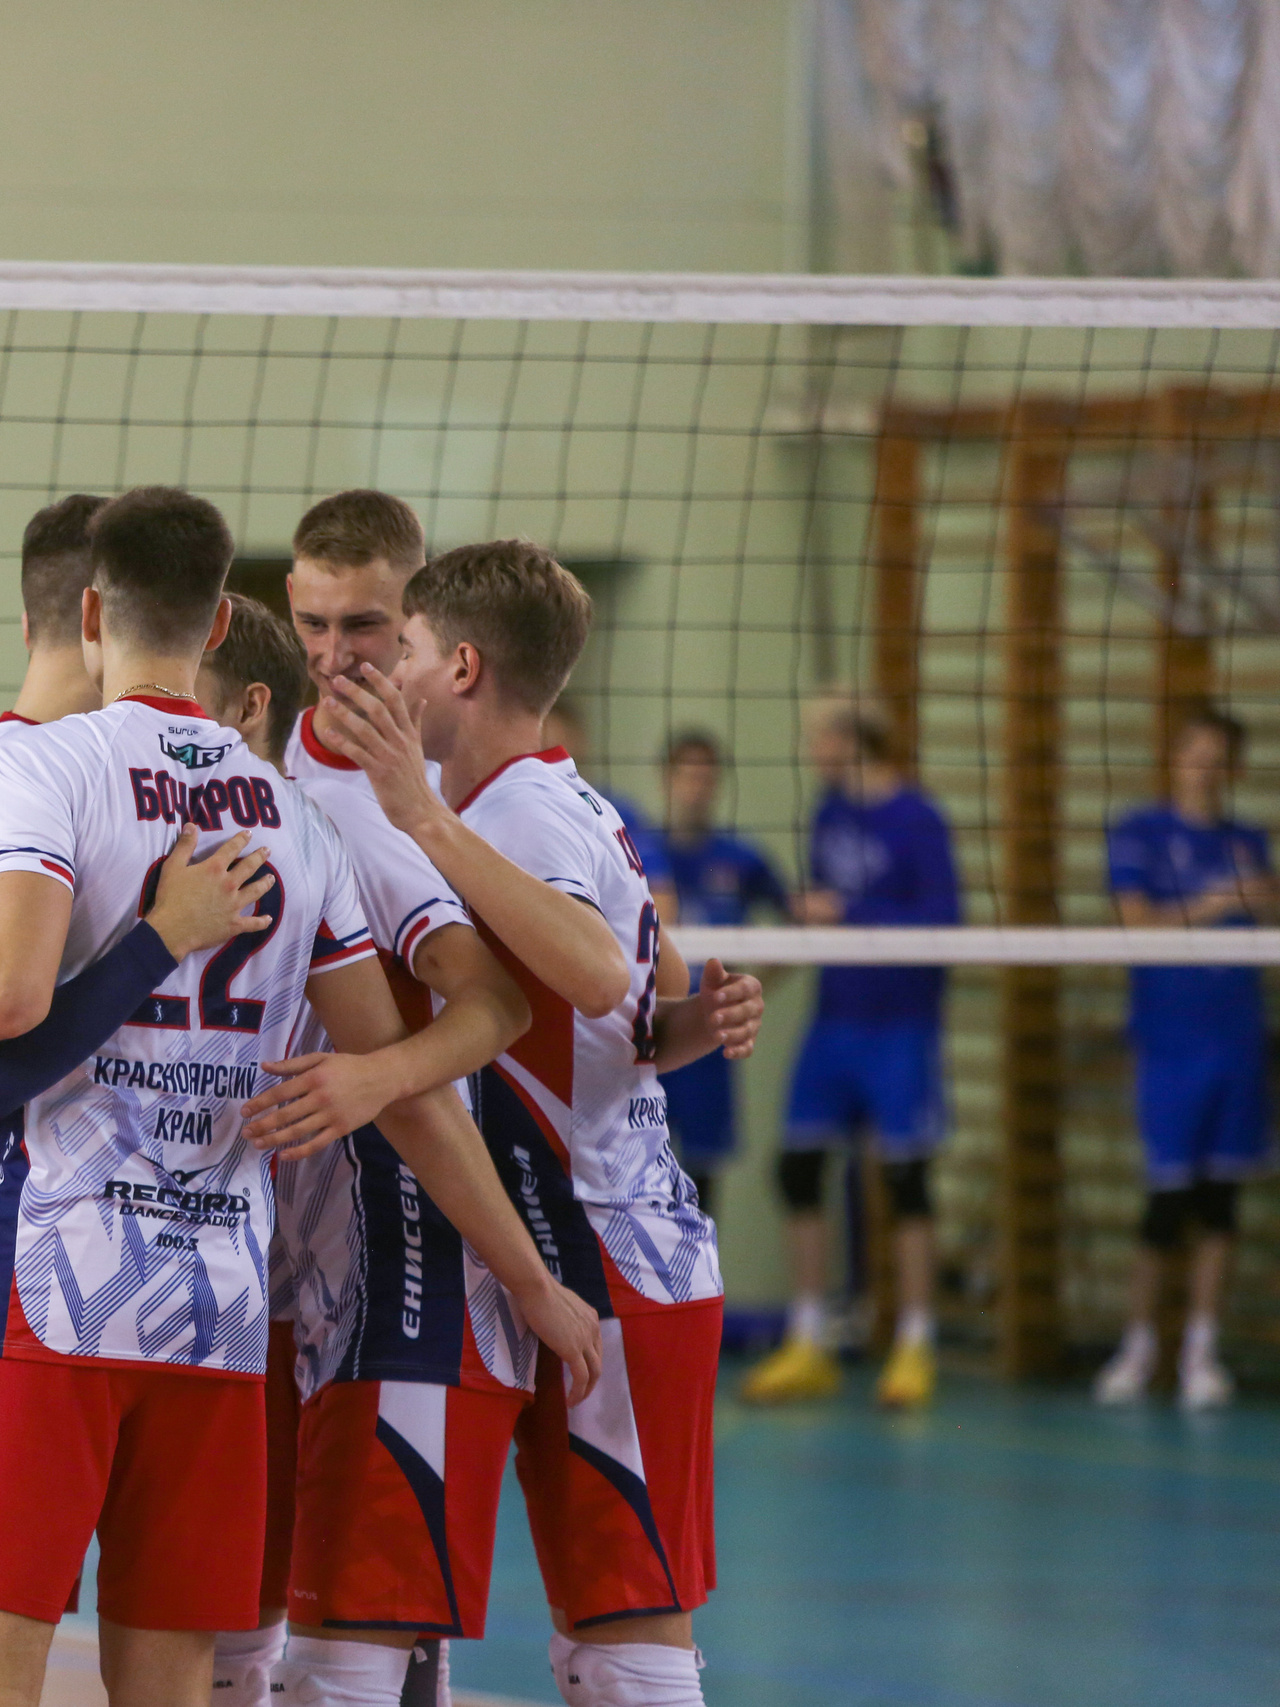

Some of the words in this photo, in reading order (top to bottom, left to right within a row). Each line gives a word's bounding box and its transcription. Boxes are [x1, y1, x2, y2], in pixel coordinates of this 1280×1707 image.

[128, 767, 282, 832] БОЧАРОВ
[94, 1055, 259, 1099] КРАСНОЯРСКИЙ
[153, 1107, 213, 1147] КРАЙ
[103, 1181, 251, 1214] RECORD
[120, 1204, 187, 1222] DANCE
[188, 1213, 240, 1228] RADIO
[156, 1233, 200, 1251] 100.3
